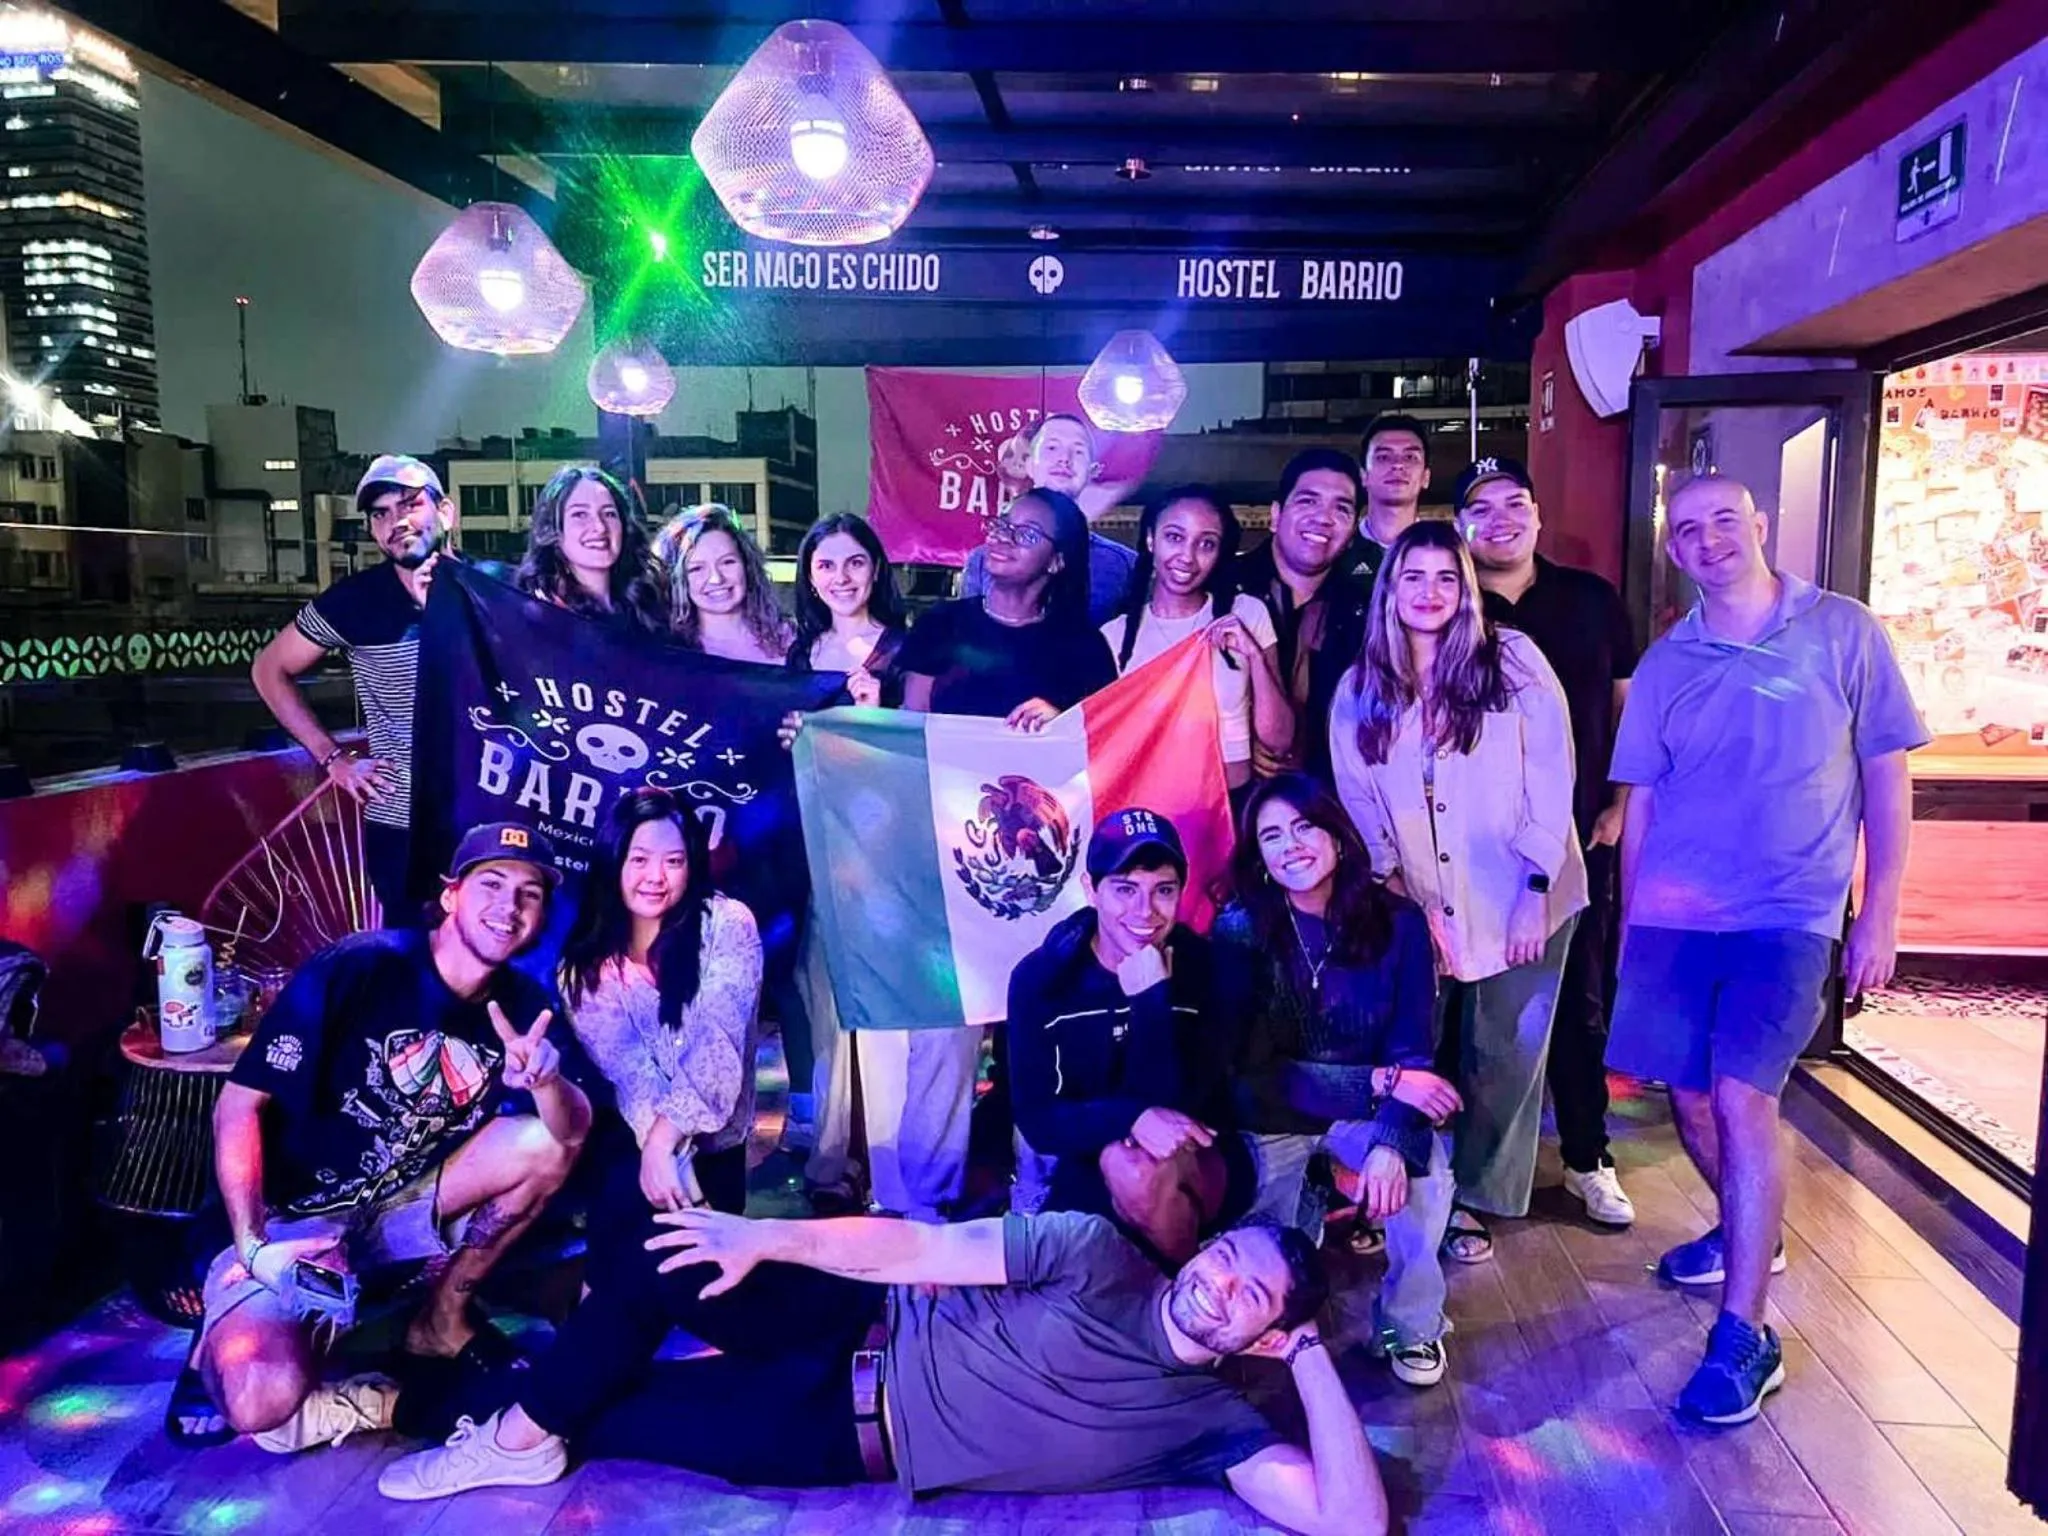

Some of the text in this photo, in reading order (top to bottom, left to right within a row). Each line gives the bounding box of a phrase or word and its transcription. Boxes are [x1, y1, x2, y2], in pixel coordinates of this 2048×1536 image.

[702, 251, 940, 291] SER NACO ES CHIDO
[1177, 258, 1404, 301] HOSTEL BARRIO
[970, 408, 1054, 434] HOST
[535, 677, 713, 748] HOSTEL
[478, 739, 727, 850] BARO
